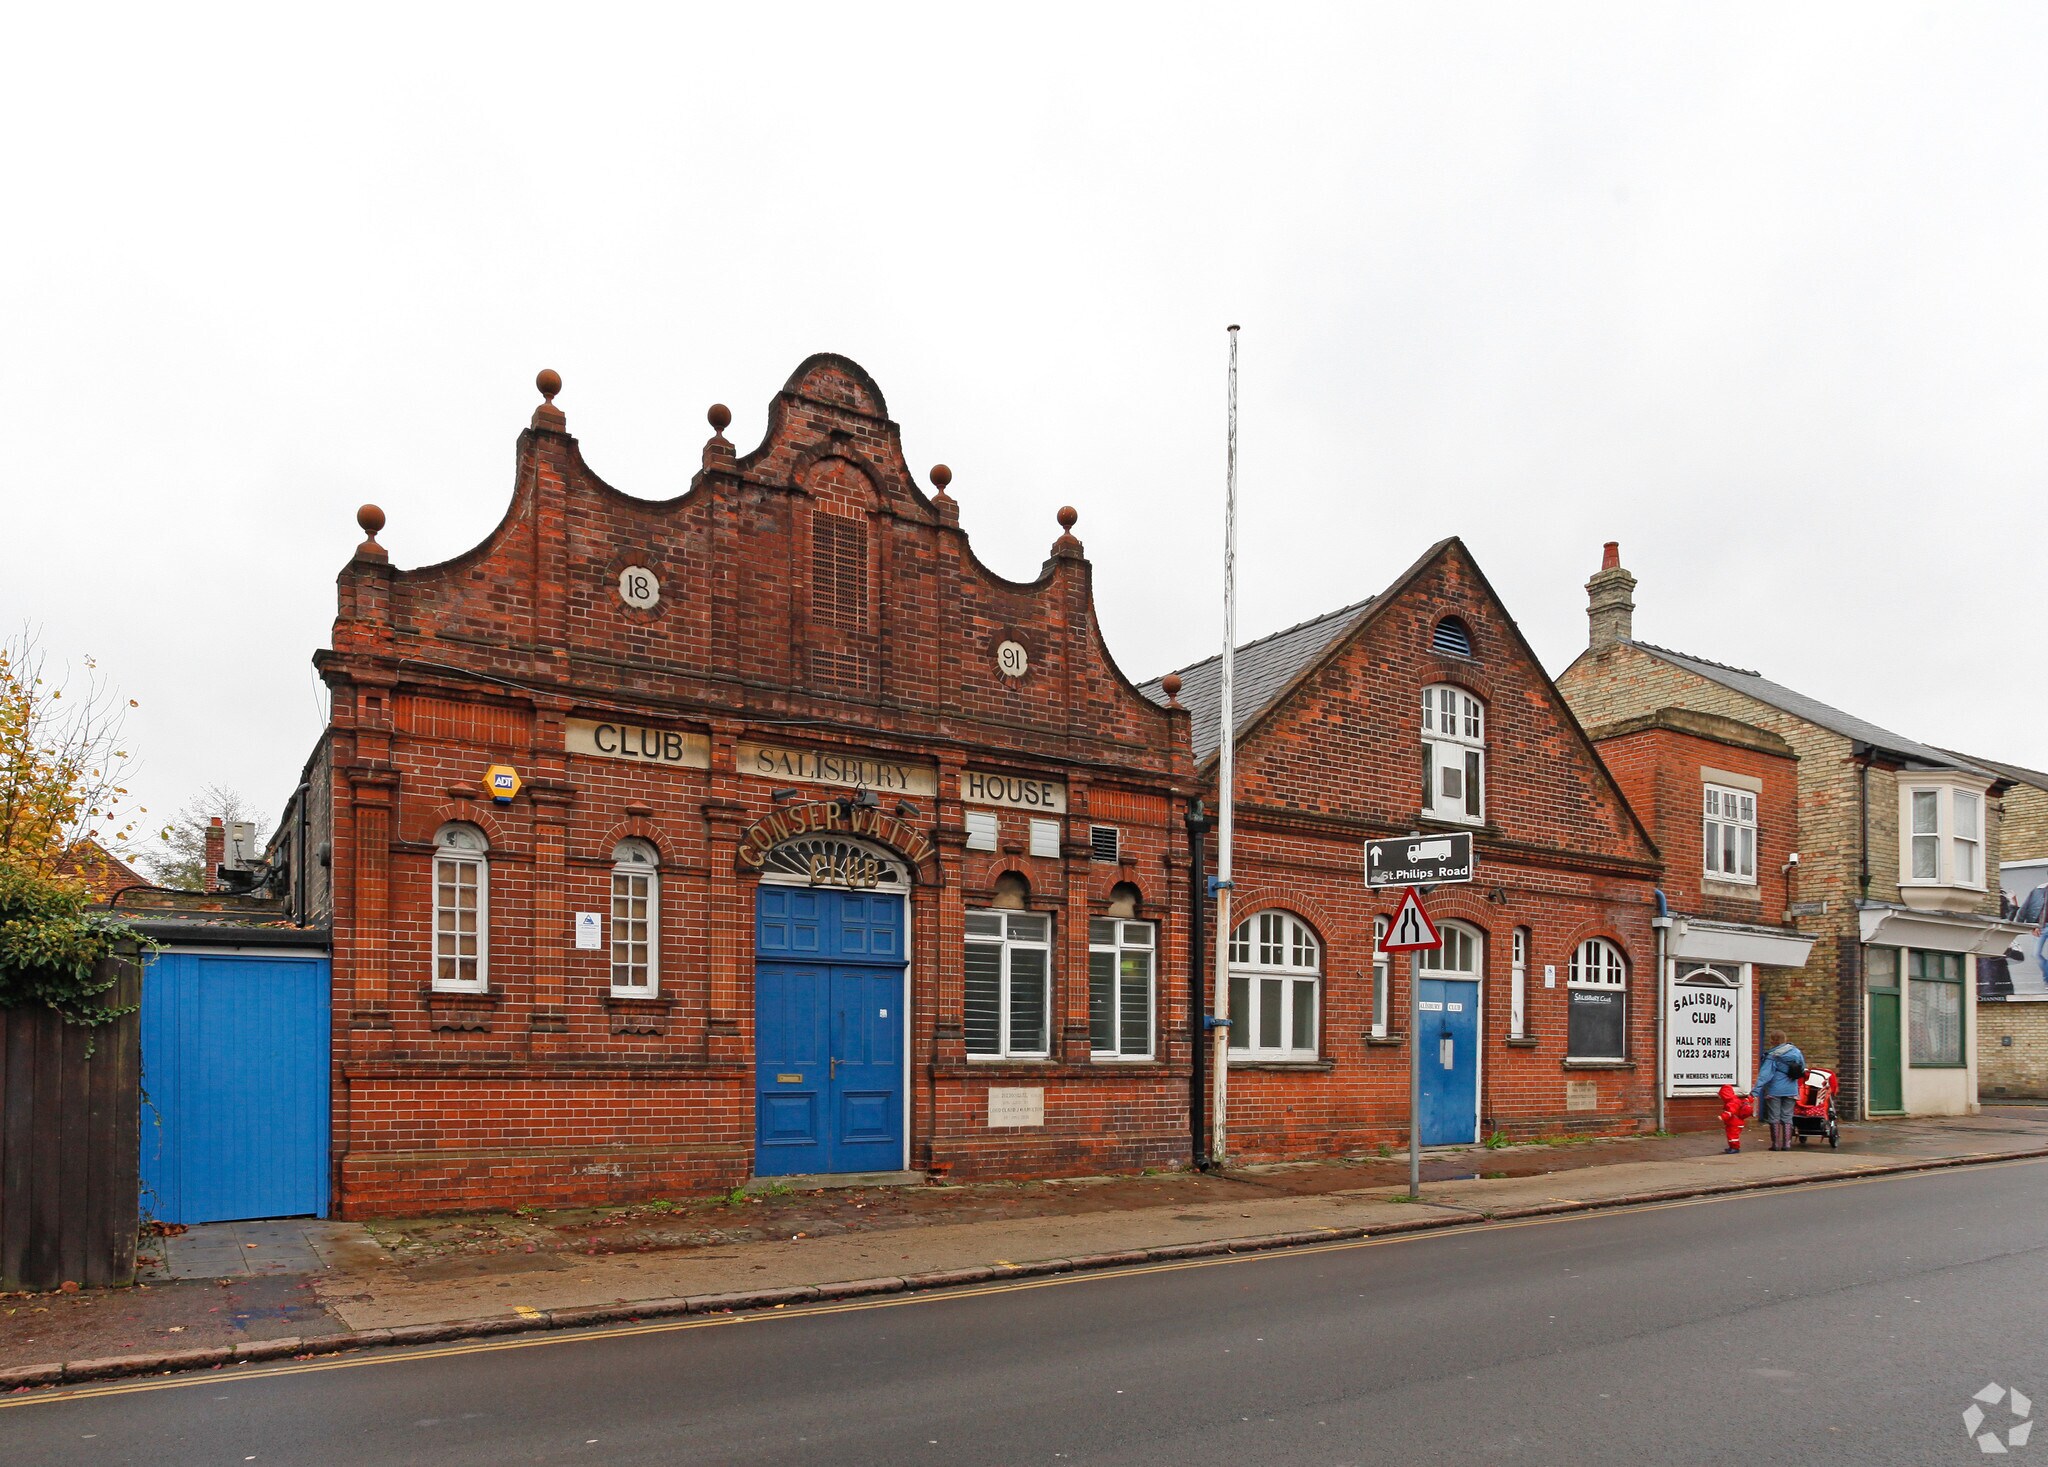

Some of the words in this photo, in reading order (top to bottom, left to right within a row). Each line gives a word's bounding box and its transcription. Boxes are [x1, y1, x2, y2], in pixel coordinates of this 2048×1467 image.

[628, 575, 650, 599] 18
[1003, 648, 1020, 670] 91
[594, 724, 683, 761] CLUB
[757, 749, 915, 790] SALISBURY
[495, 776, 512, 788] ADT
[969, 773, 1056, 807] HOUSE
[810, 853, 879, 888] CLUB
[1439, 866, 1468, 876] Road
[1674, 993, 1733, 1013] SALISBURY
[1692, 1012, 1716, 1024] CLUB
[1676, 1036, 1694, 1045] HALL
[1697, 1037, 1711, 1046] FOR
[1714, 1037, 1731, 1046] HIRE
[1677, 1049, 1700, 1058] 01223
[1702, 1049, 1730, 1058] 248734
